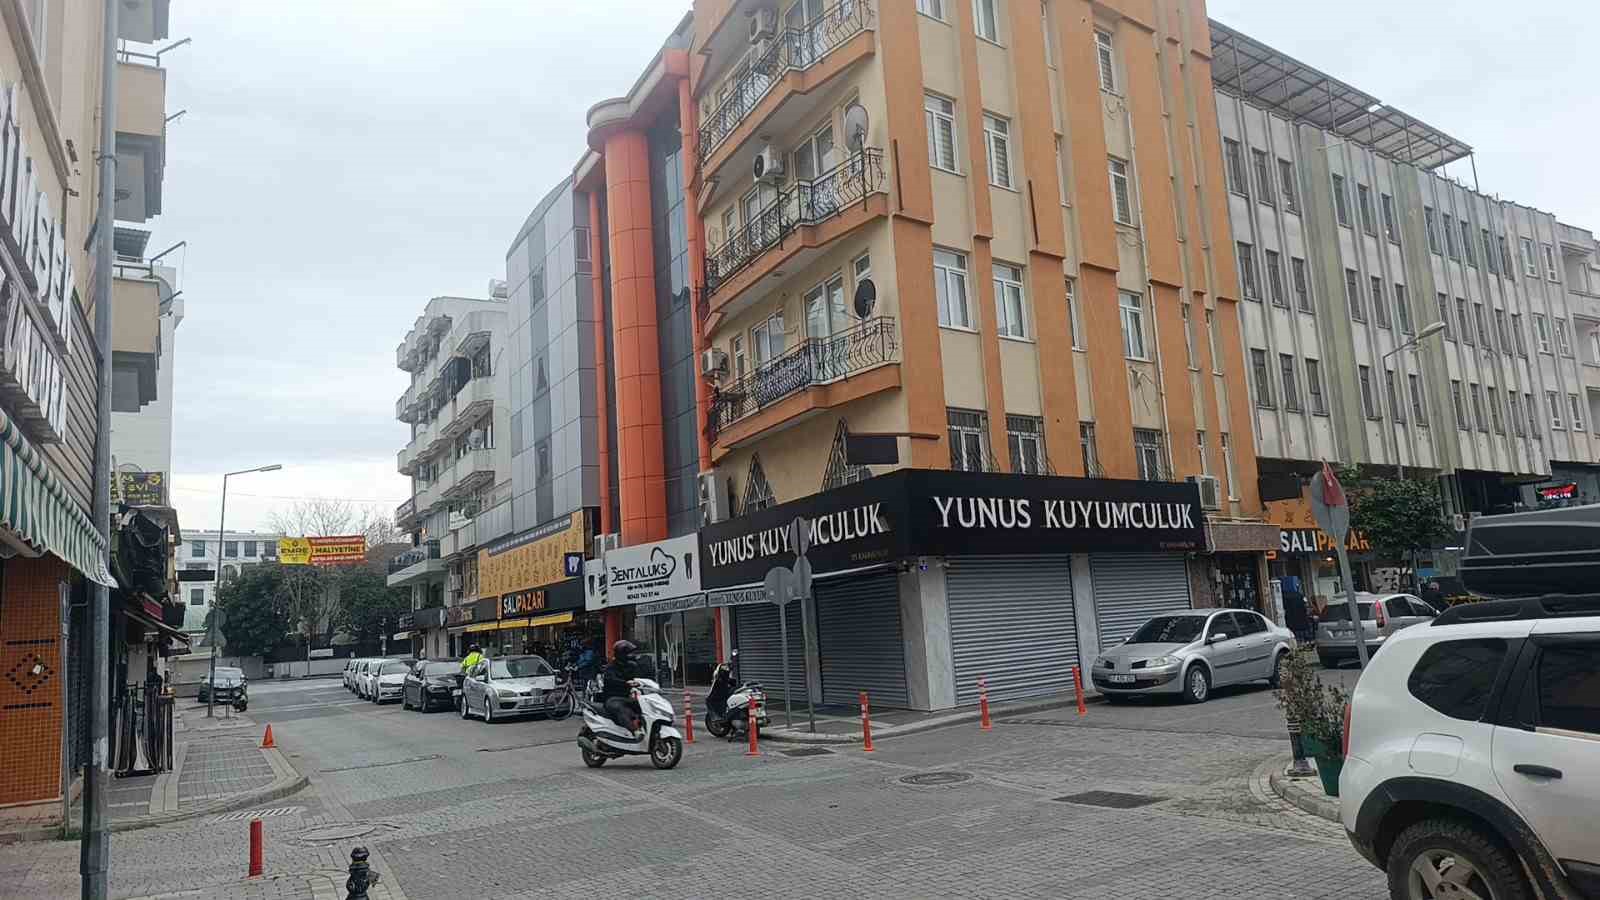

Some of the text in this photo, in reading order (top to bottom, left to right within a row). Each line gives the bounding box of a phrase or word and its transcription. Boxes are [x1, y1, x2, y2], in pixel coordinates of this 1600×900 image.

[933, 495, 1195, 529] YUNUS KUYUMCULUK
[708, 502, 885, 567] YUNUS KUYMCULUK
[610, 562, 668, 583] DENTALUKS
